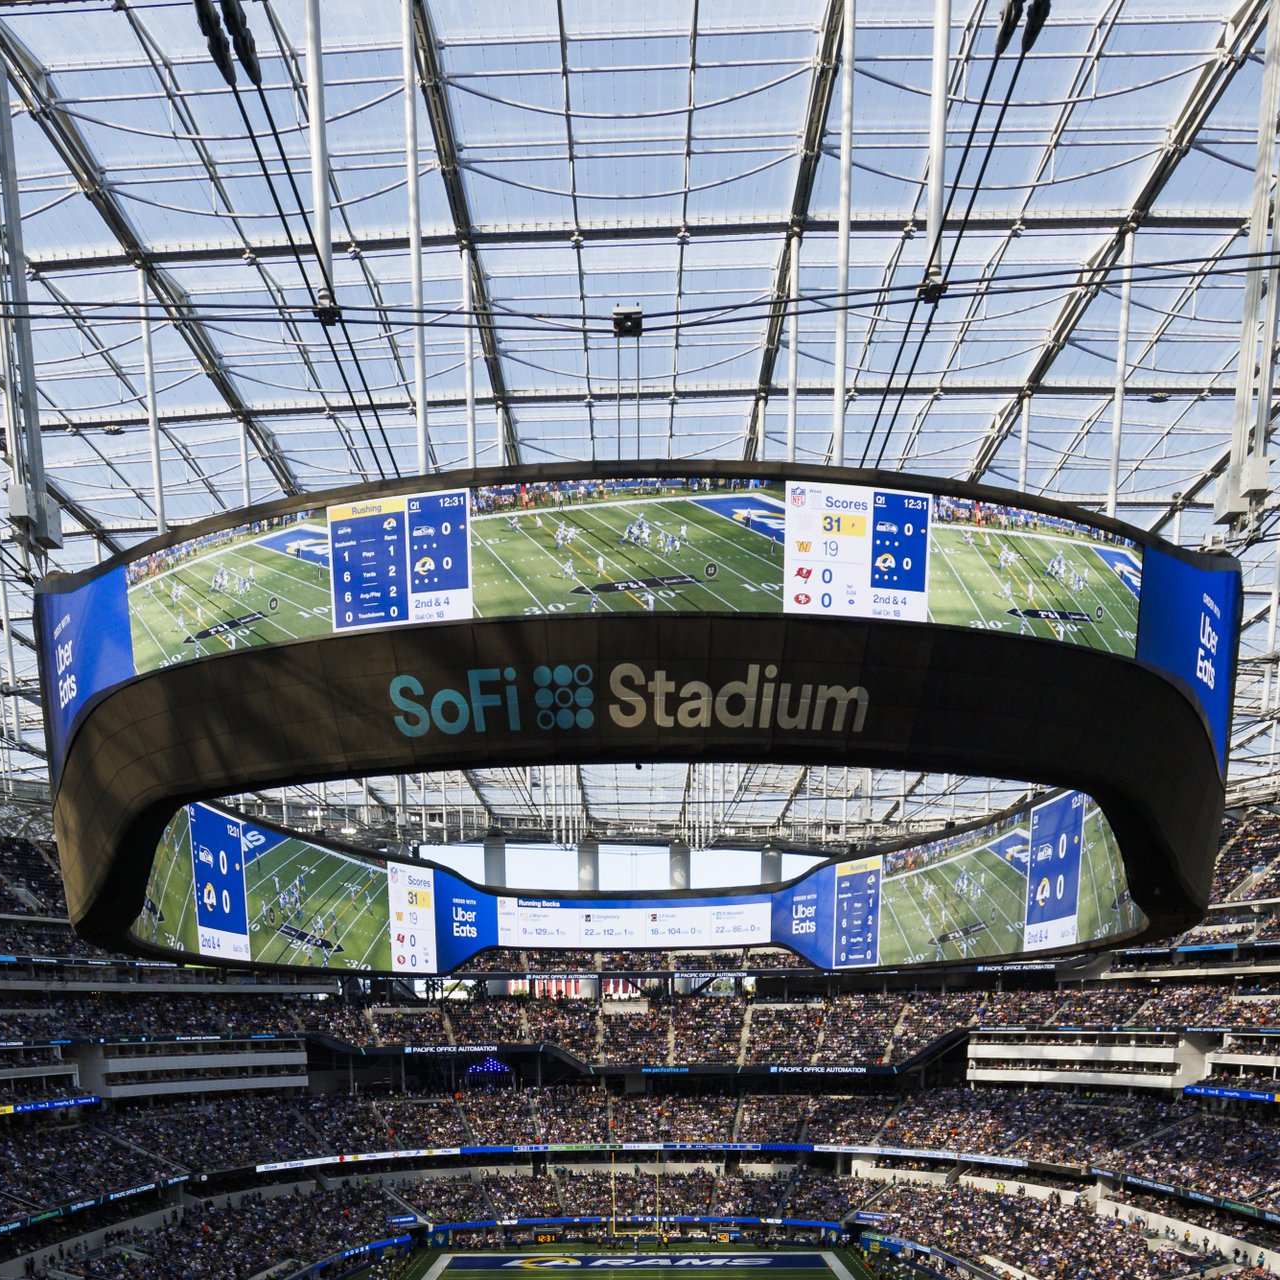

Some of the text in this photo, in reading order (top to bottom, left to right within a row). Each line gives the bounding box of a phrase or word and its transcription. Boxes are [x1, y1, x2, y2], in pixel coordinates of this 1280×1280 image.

[352, 505, 382, 516] Rushing
[410, 496, 464, 511] Q1 12:31
[825, 496, 869, 511] Scores
[876, 496, 927, 510] Q1 12:31
[442, 522, 451, 536] 0
[823, 516, 841, 532] 31
[904, 523, 914, 536] 0
[344, 545, 395, 562] 1 1
[822, 540, 838, 557] 19
[442, 557, 452, 570] 0
[902, 557, 912, 570] 0
[343, 565, 396, 583] 6 2
[822, 568, 833, 584] 0
[344, 586, 397, 603] 6 2
[821, 593, 832, 608] 0
[873, 594, 907, 605] 2nd & 4
[415, 596, 450, 609] 2nd 4
[345, 606, 398, 622] 0 0
[1200, 611, 1218, 655] Uber
[55, 640, 73, 676] Uber
[1196, 647, 1215, 690] Eats
[58, 674, 77, 710] Eats
[389, 662, 869, 738] SoFi Stadium
[1059, 833, 1067, 860] 0
[219, 850, 228, 875] 0
[408, 875, 431, 888] Scores
[1056, 874, 1064, 900] 0
[222, 889, 231, 913] 0
[408, 892, 417, 905] 31
[519, 900, 541, 908] Running
[409, 911, 418, 925] 19
[453, 906, 476, 922] Uber
[792, 904, 816, 919] Uber
[453, 922, 477, 937] Eats
[792, 920, 816, 934] Eats
[201, 935, 212, 949] 2nd
[410, 934, 416, 947] 0
[410, 954, 417, 967] 0
[589, 1258, 773, 1266] RAMS
